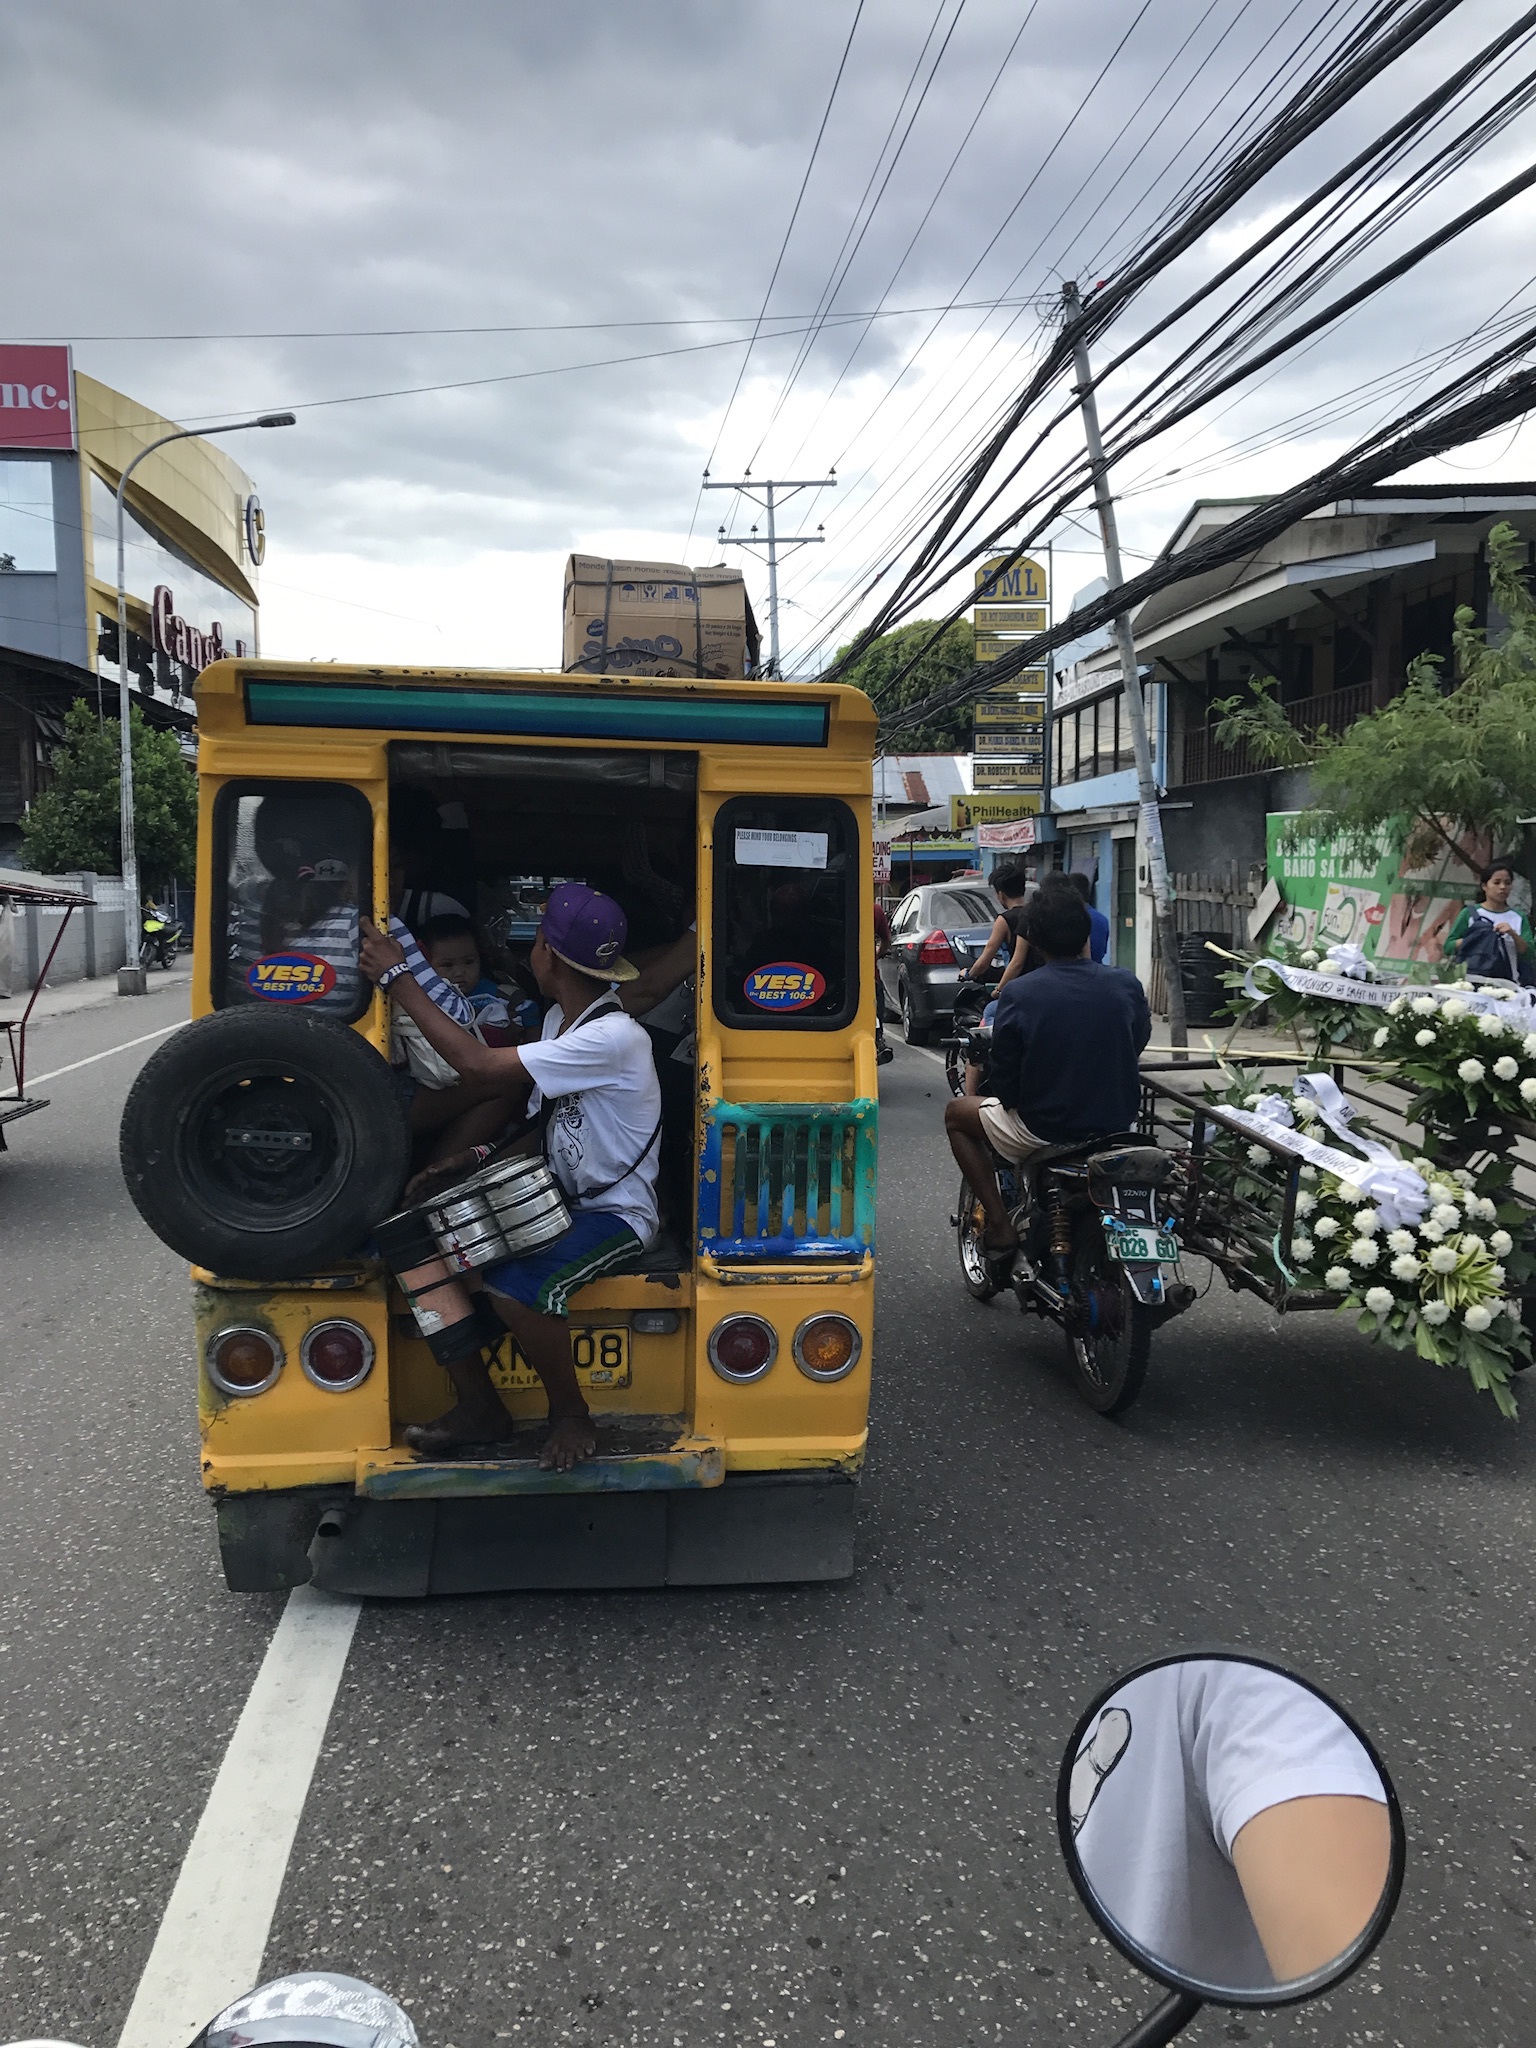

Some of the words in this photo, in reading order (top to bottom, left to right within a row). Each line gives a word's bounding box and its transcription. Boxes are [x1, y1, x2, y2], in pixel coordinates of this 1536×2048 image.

[976, 766, 986, 776] DR.
[988, 766, 1010, 776] ROBERT
[973, 806, 1034, 817] PhilHealth
[1283, 858, 1316, 878] BAHO
[1320, 858, 1336, 878] SA
[257, 964, 325, 982] YES!
[262, 982, 293, 992] BEST
[296, 983, 325, 992] 106.3
[754, 973, 815, 990] YES!
[759, 991, 786, 1000] BEST
[789, 992, 815, 1000] 106.3
